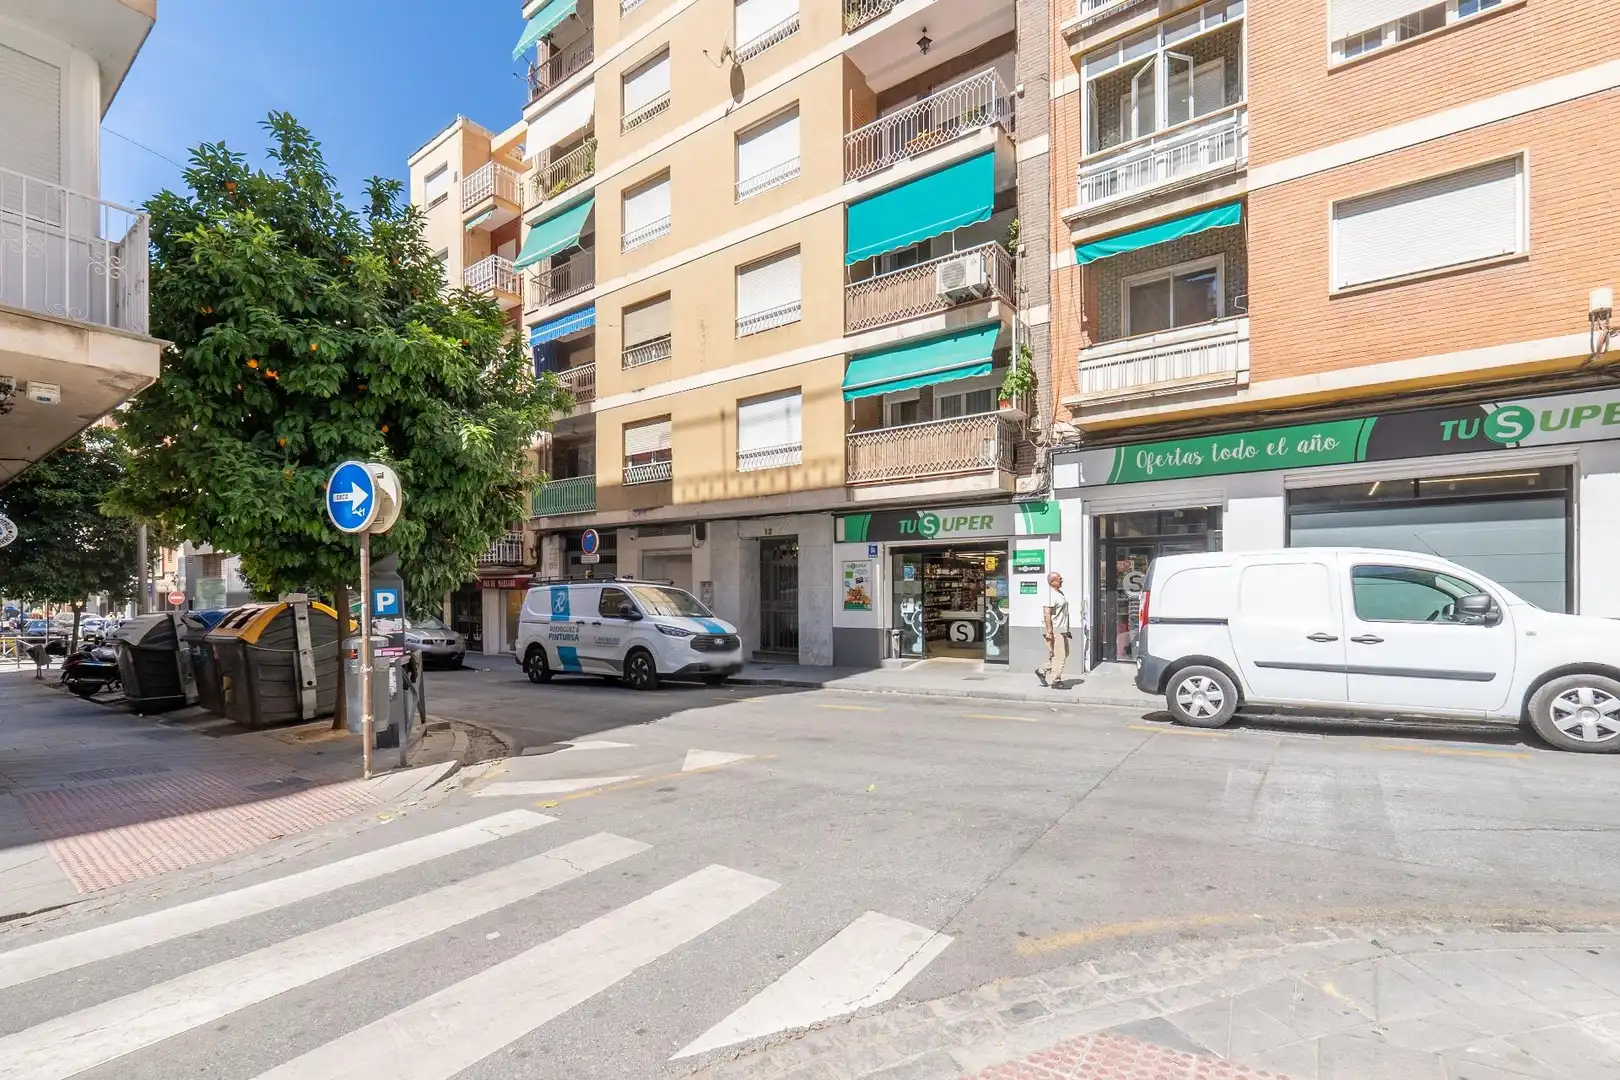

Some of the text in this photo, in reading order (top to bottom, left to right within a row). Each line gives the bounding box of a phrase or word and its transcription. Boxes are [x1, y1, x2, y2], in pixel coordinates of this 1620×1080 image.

[1440, 402, 1620, 441] TU SUPE
[1136, 433, 1340, 475] Ofertas todo el año
[764, 528, 773, 536] 12
[898, 514, 994, 536] TU SUPER
[376, 592, 395, 612] P
